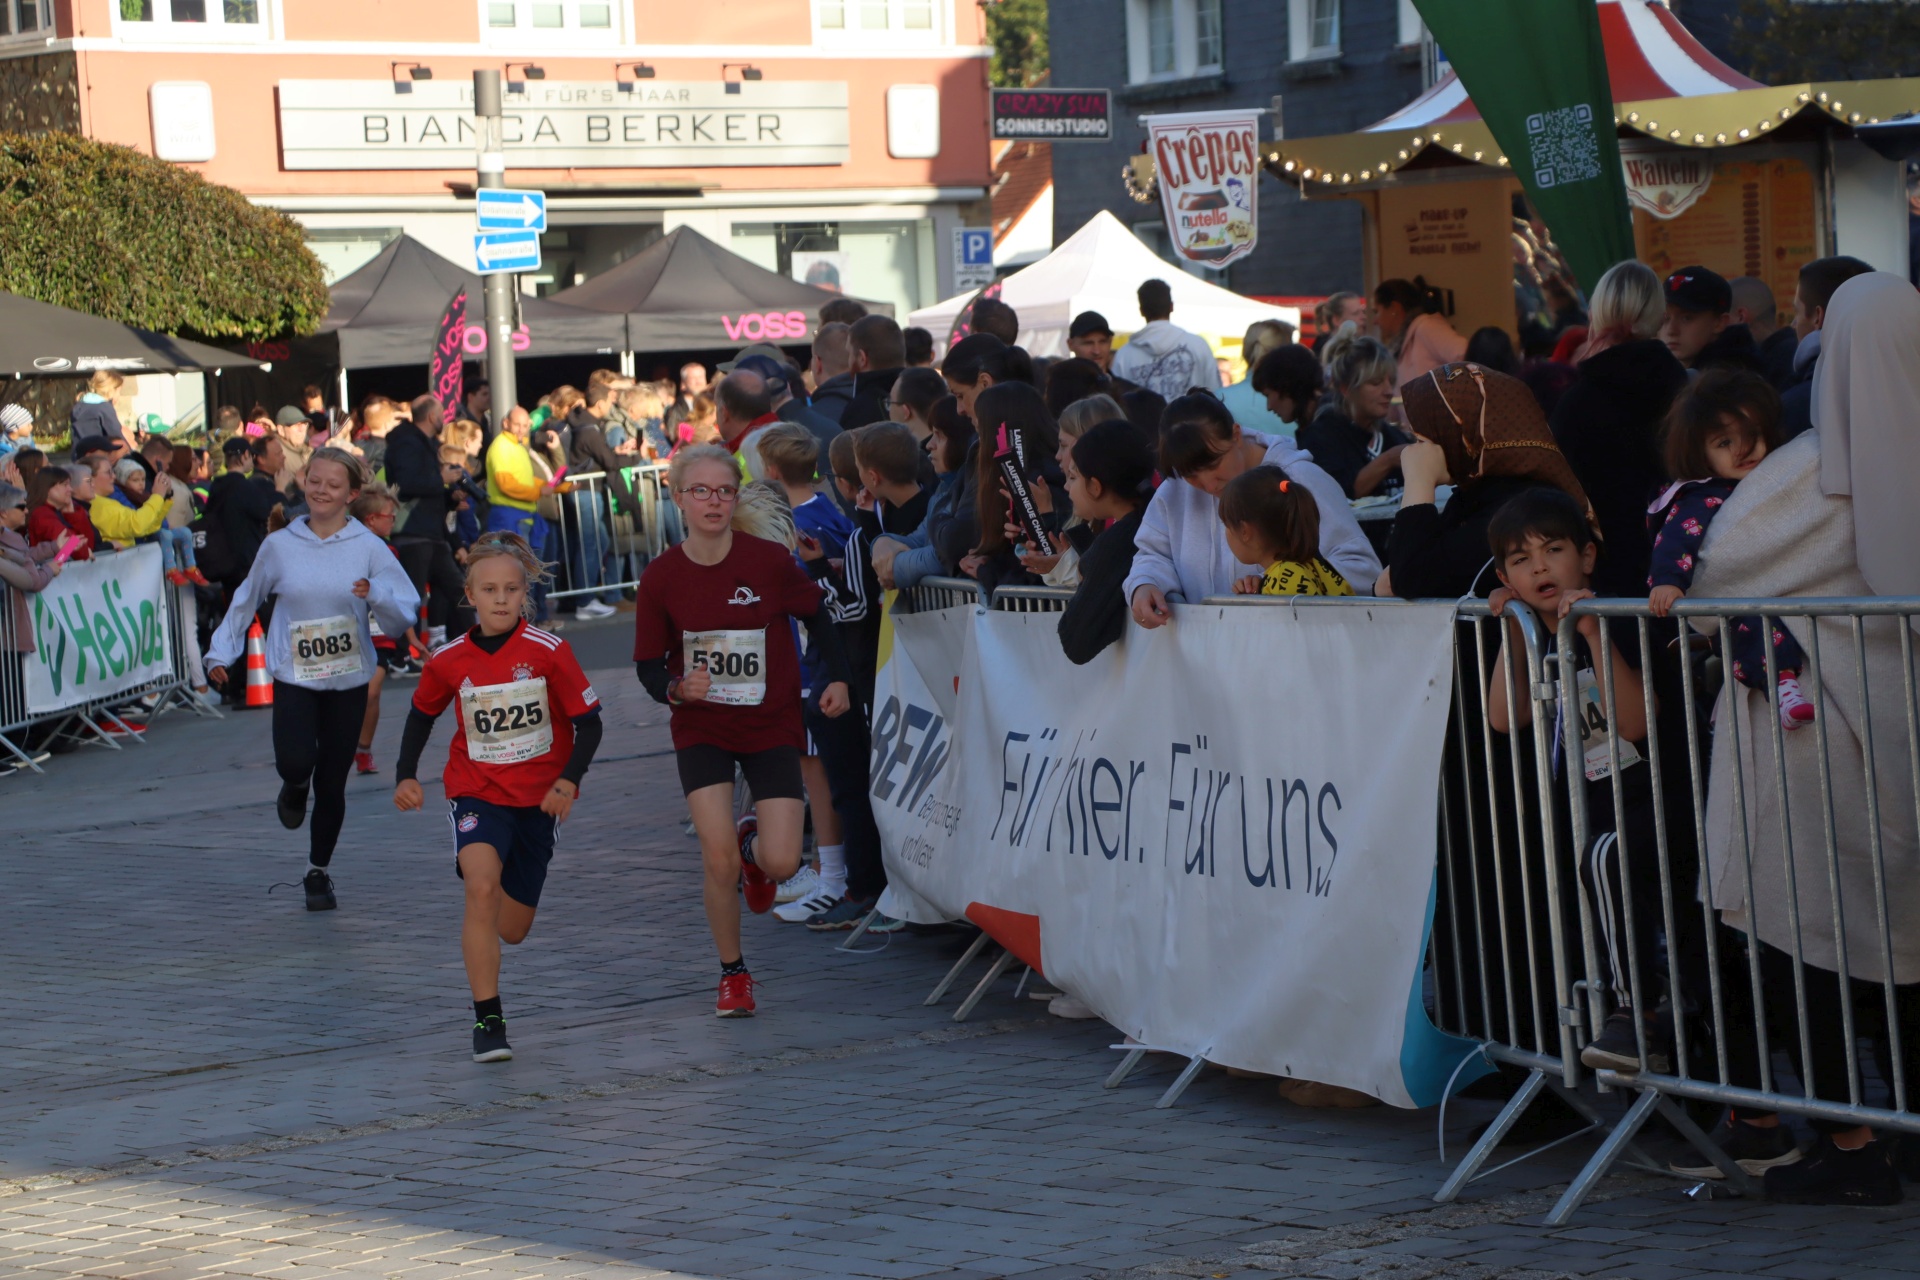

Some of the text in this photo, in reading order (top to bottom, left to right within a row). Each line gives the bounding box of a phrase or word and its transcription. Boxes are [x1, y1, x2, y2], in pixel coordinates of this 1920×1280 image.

[459, 85, 531, 102] IEN
[627, 87, 690, 102] HAAR
[996, 94, 1106, 116] CRAZY SUN
[587, 114, 781, 142] BERKER
[996, 118, 1107, 136] SONNENSTUDIO
[1156, 125, 1254, 189] Crêpes
[1182, 208, 1228, 228] nutella
[968, 234, 985, 261] P
[722, 311, 808, 341] VOSS
[1004, 459, 1027, 498] LAUFEND
[1021, 496, 1037, 519] NEUE
[1031, 518, 1054, 558] CHANCEN
[57, 578, 164, 685] Helios
[298, 632, 353, 659] 6083
[692, 649, 760, 677] 5306
[474, 700, 543, 734] 6225
[496, 750, 516, 759] VOSS
[516, 747, 532, 756] BEW
[869, 694, 954, 813] BEW
[991, 727, 1063, 849] Für
[1046, 728, 1144, 864] hier.
[1164, 734, 1231, 878] Für
